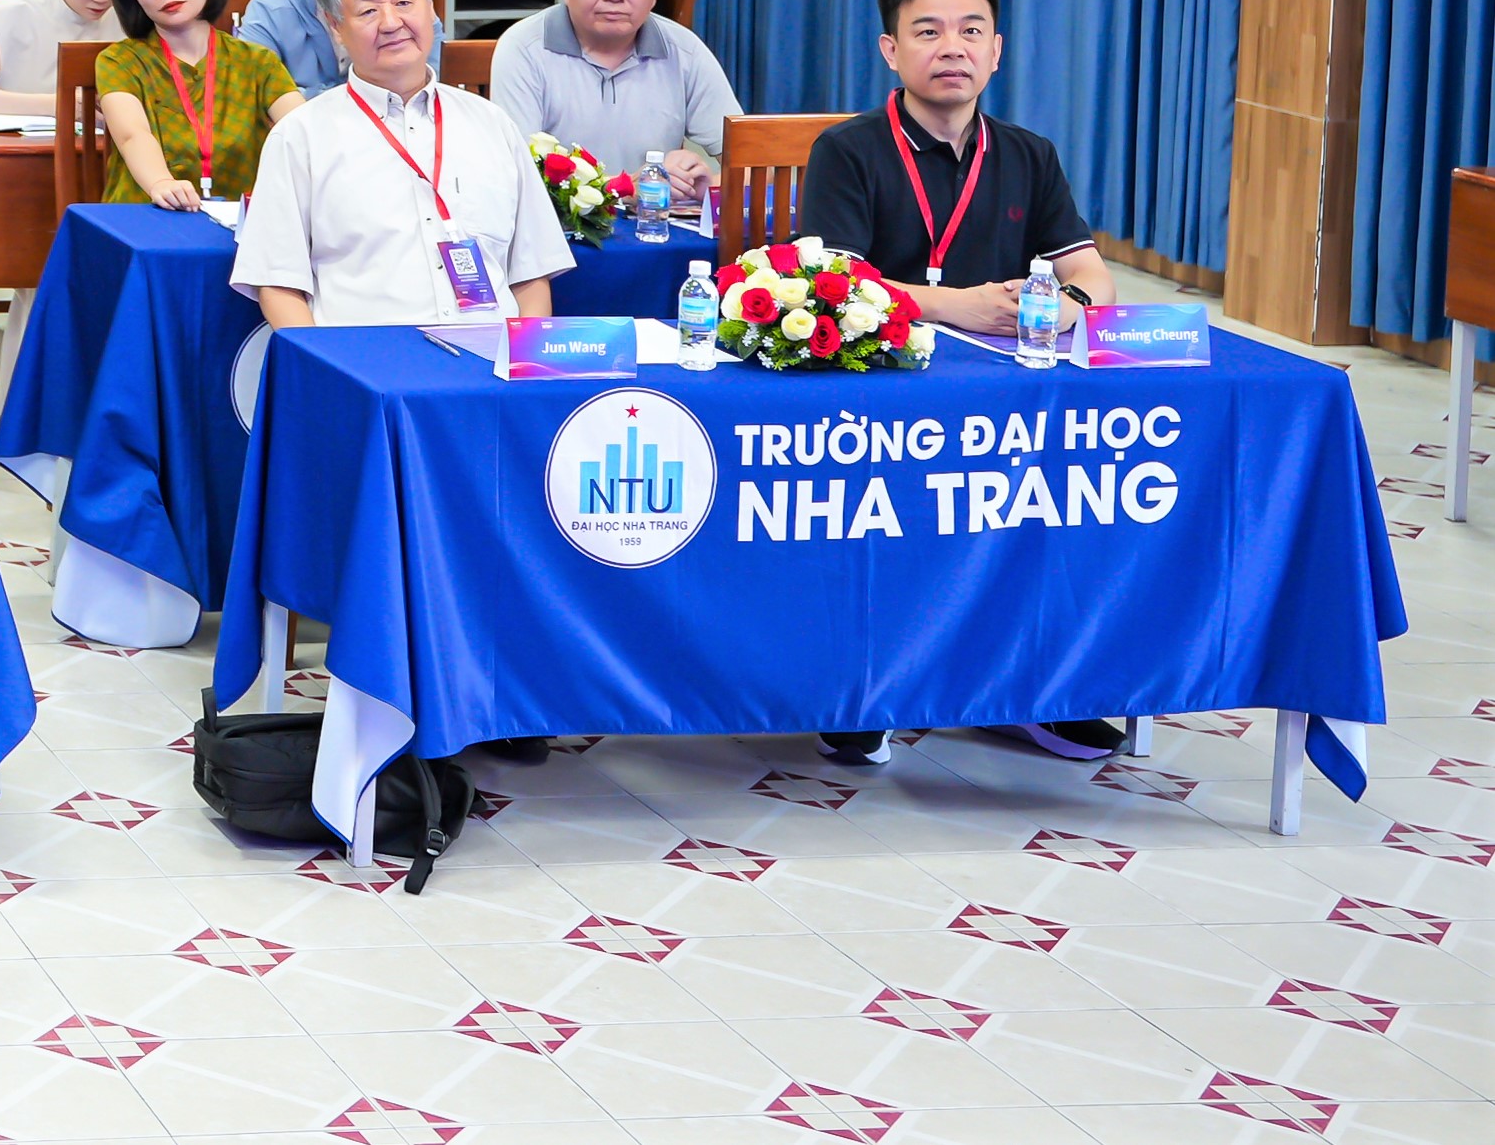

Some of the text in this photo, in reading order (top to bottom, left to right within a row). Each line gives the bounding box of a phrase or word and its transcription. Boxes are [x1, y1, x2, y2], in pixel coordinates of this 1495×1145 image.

[1096, 328, 1198, 345] Yiu-ming Cheung
[542, 341, 606, 355] Jun Wang
[735, 406, 1181, 468] TRƯỜNG ĐẠI HỌC
[589, 478, 674, 514] NTU
[738, 461, 1179, 541] NHA TRANG
[571, 520, 688, 534] ĐẠI HỌC NHA TRANG
[619, 537, 642, 546] 1959
